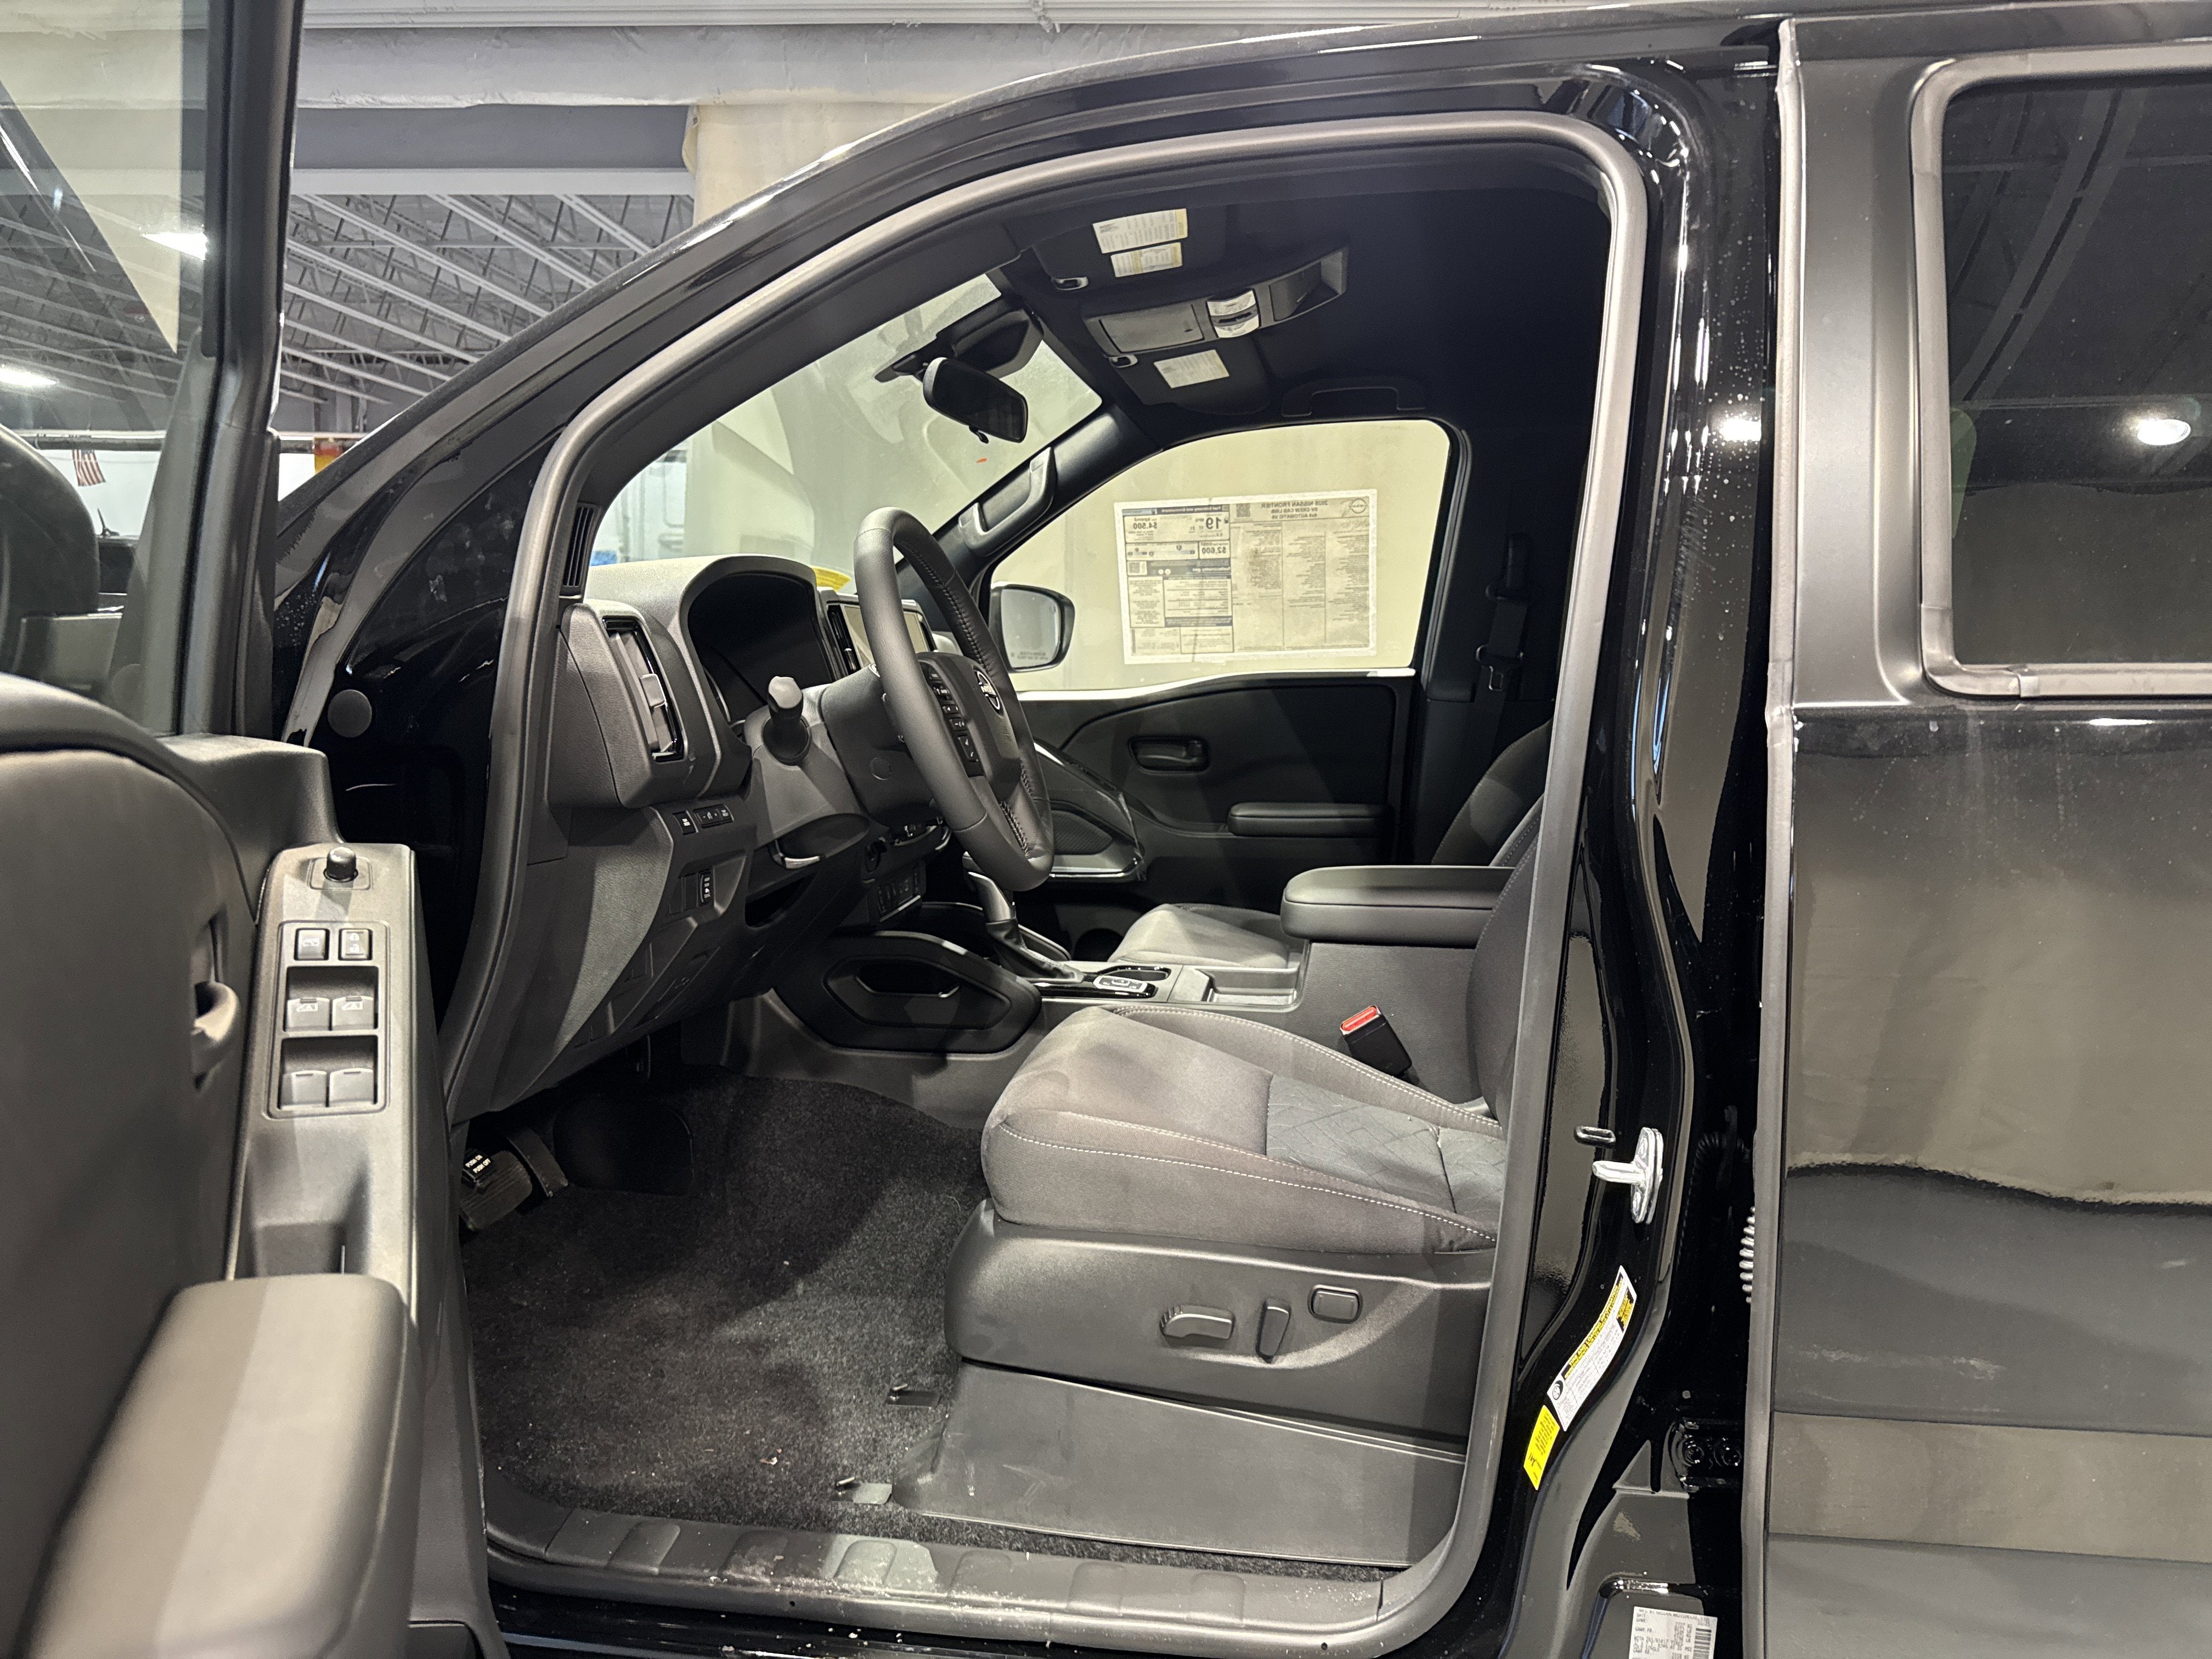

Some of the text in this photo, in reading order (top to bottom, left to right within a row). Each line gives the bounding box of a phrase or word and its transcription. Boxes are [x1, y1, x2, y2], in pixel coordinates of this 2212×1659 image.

[472, 1163, 486, 1173] PUSH
[1577, 1344, 1587, 1356] AND
[1586, 1322, 1602, 1344] LOADING
